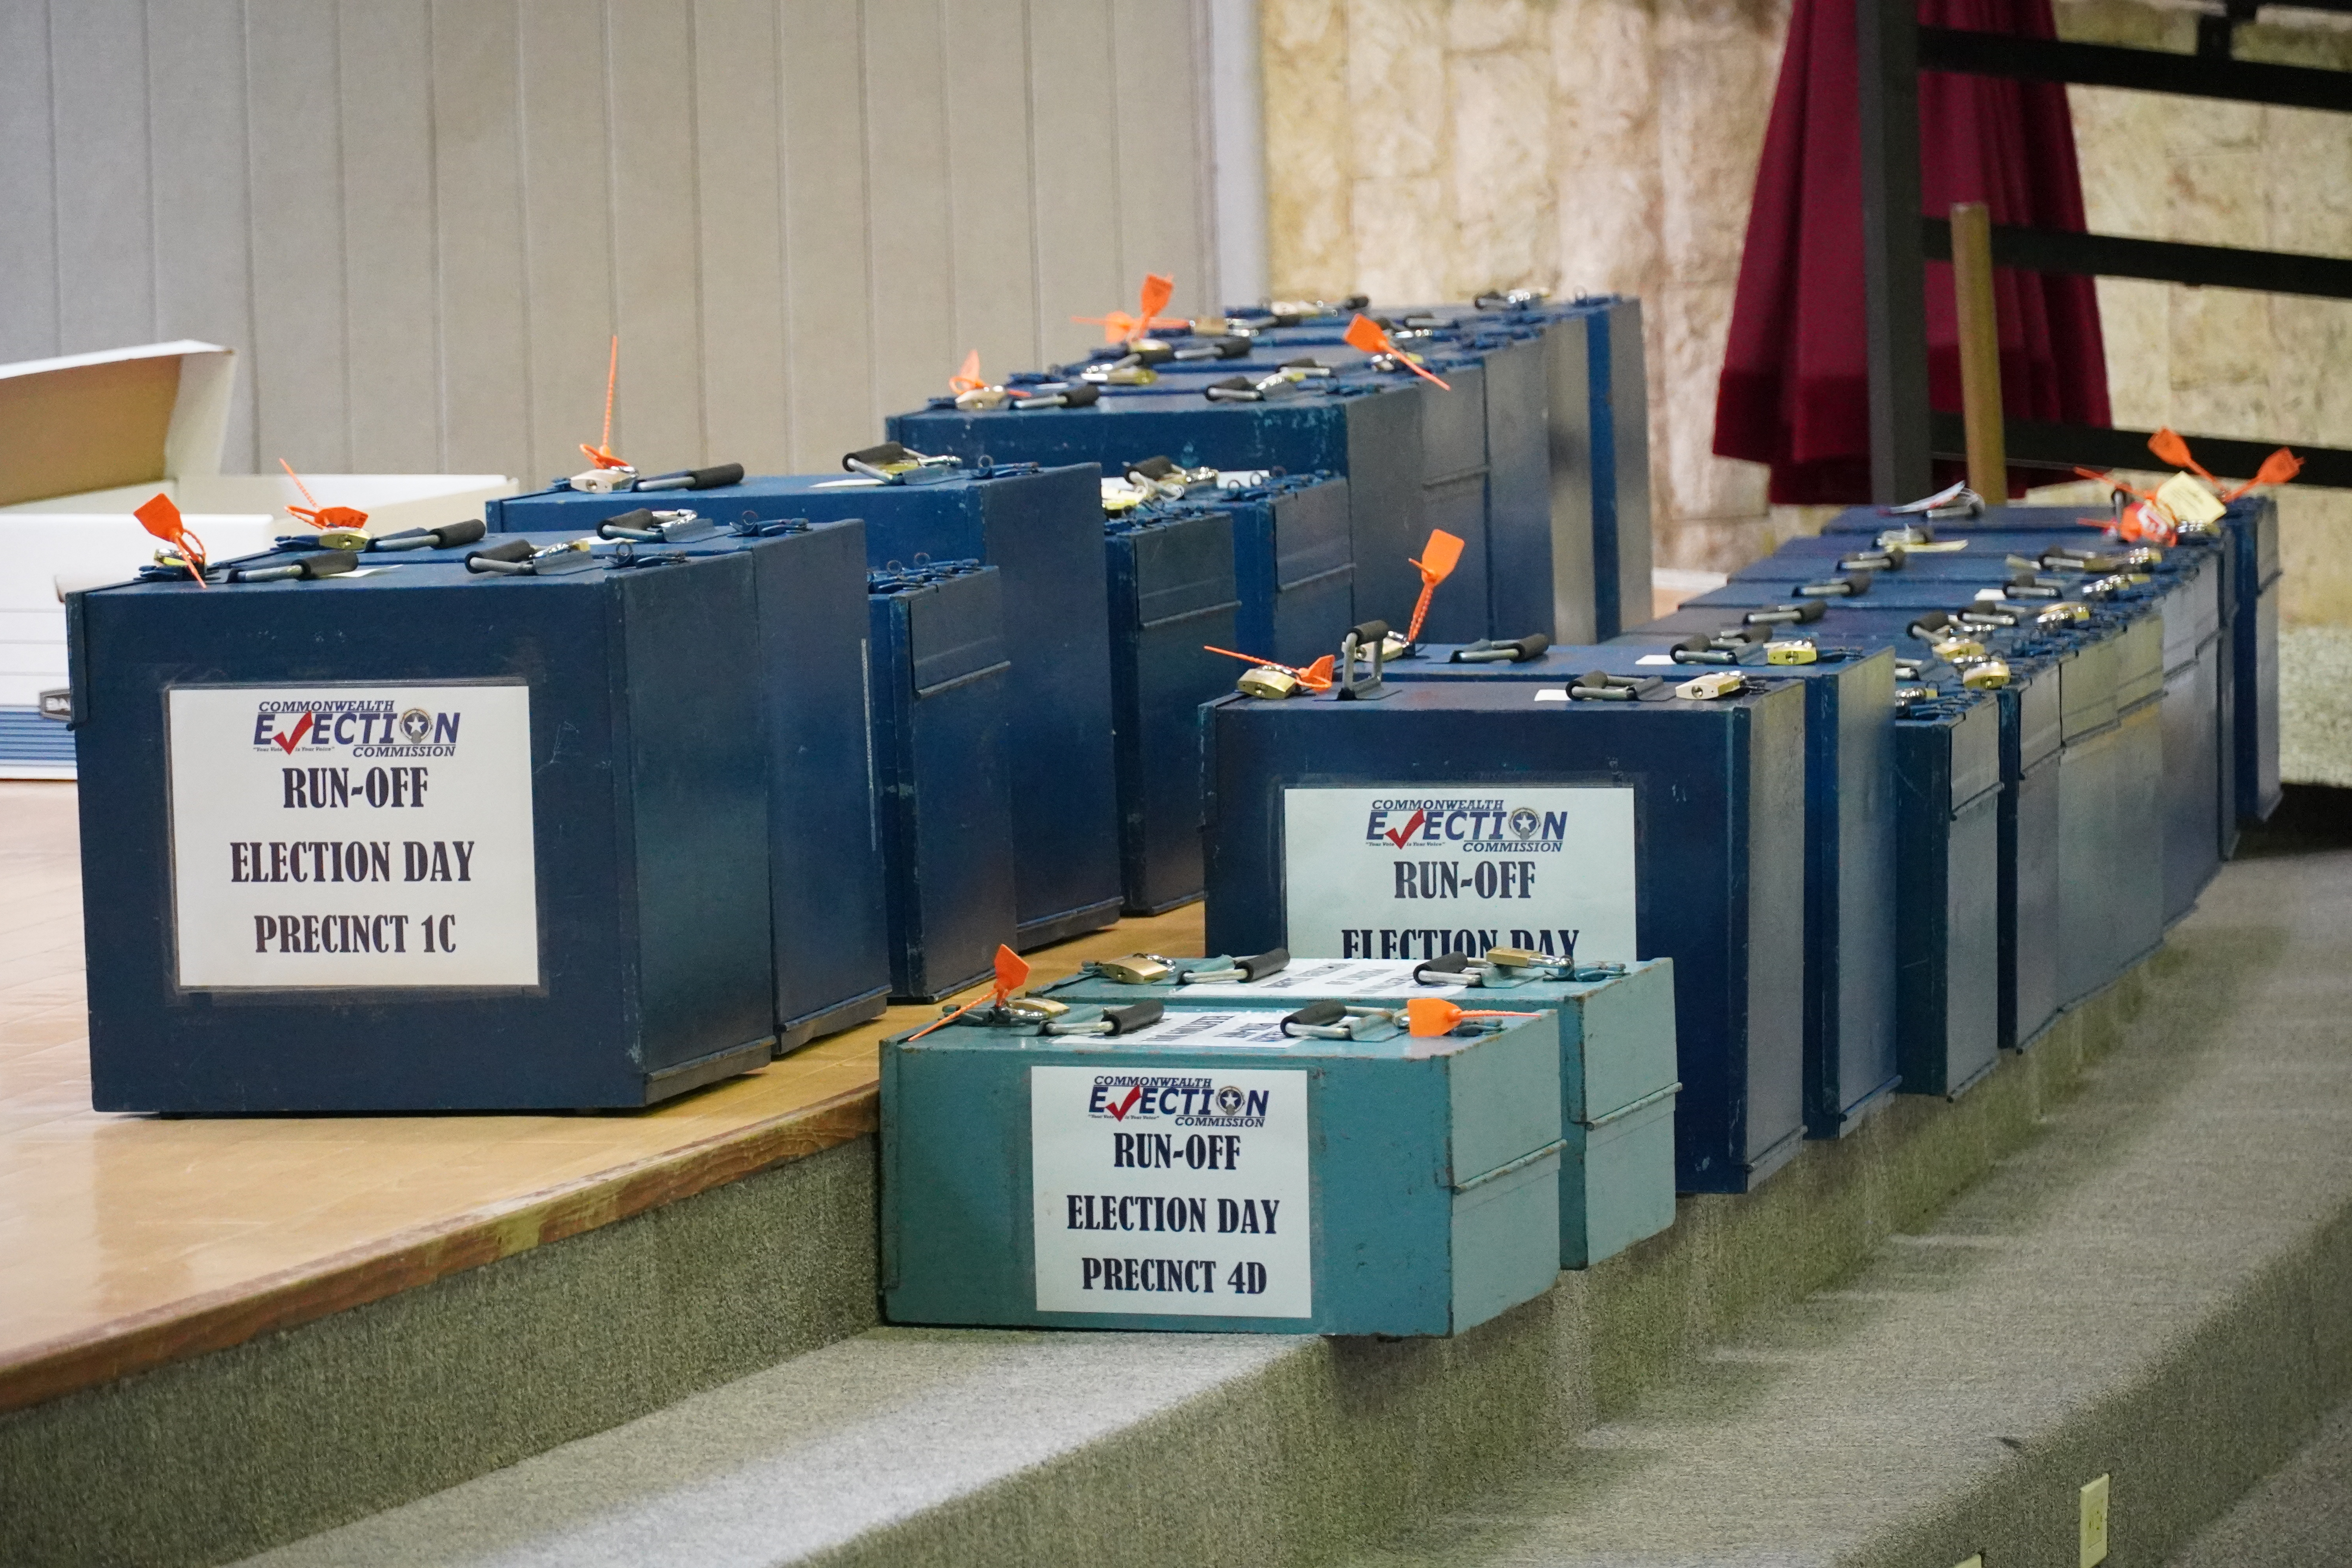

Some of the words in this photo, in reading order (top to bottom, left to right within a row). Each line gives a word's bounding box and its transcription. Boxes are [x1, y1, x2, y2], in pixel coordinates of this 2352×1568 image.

[259, 700, 394, 712] COMMONWEALTH
[353, 746, 456, 757] COMMISSION
[282, 767, 428, 808] RUN-OFF
[1372, 800, 1504, 810] COMMONWEALTH
[230, 841, 390, 882] ELECTION
[403, 841, 475, 882] DAY
[1463, 842, 1562, 852] COMMISSION
[1394, 860, 1535, 899] RUN-OFF
[254, 915, 408, 953] PRECINCT
[421, 915, 456, 953] 1C
[1094, 1076, 1212, 1089] COMMONWEALTH
[1175, 1117, 1265, 1127] COMMISSION
[1114, 1132, 1241, 1170] RUN-OFF
[1067, 1195, 1206, 1232] ELECTION
[1218, 1198, 1280, 1234] DAY
[1082, 1258, 1216, 1293] PRECINCT
[1227, 1261, 1267, 1294] 4D
